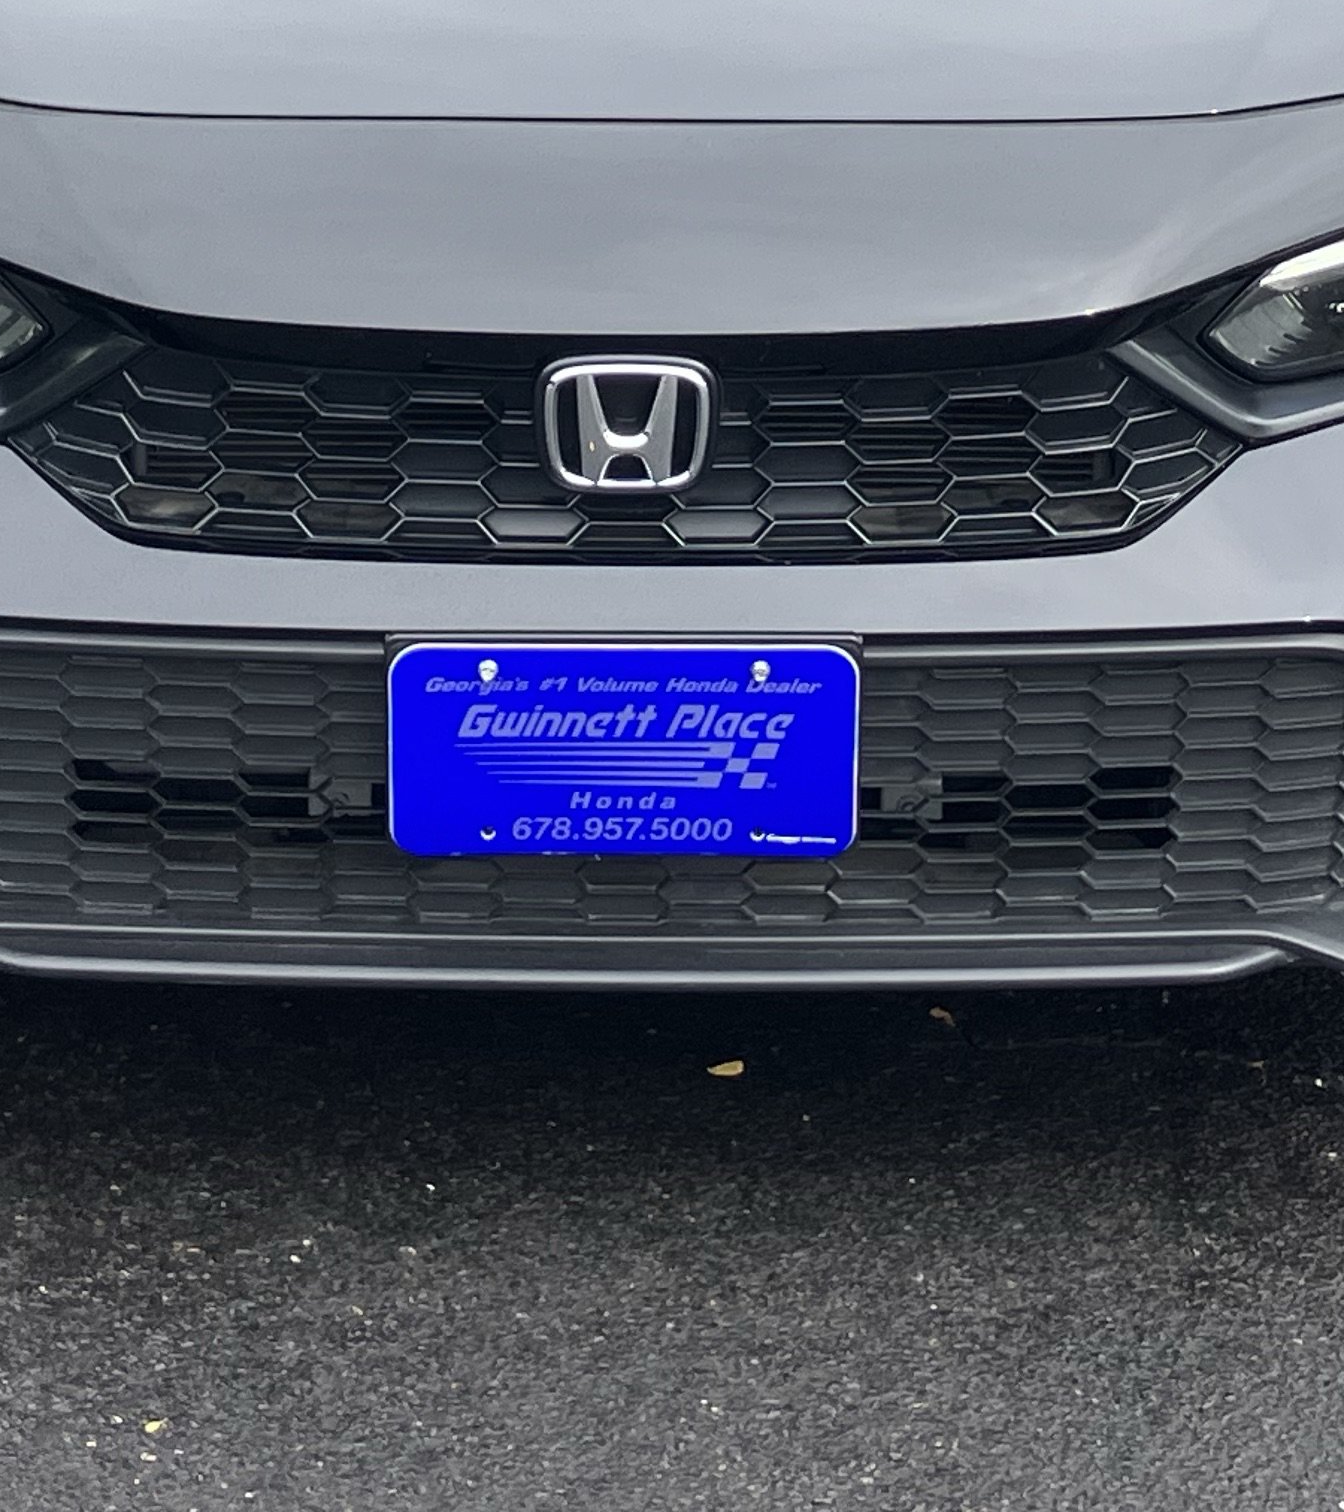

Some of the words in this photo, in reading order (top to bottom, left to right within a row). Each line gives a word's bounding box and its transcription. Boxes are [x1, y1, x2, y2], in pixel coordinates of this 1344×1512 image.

[425, 676, 530, 696] Georgia's
[539, 676, 568, 692] #1
[578, 676, 659, 693] Volume
[666, 677, 739, 694] Honda
[745, 677, 823, 694] Dealer
[457, 703, 658, 738] Gwinnett
[665, 703, 796, 739] Place
[569, 791, 677, 810] Honda
[511, 816, 733, 842] 678.957.5000
